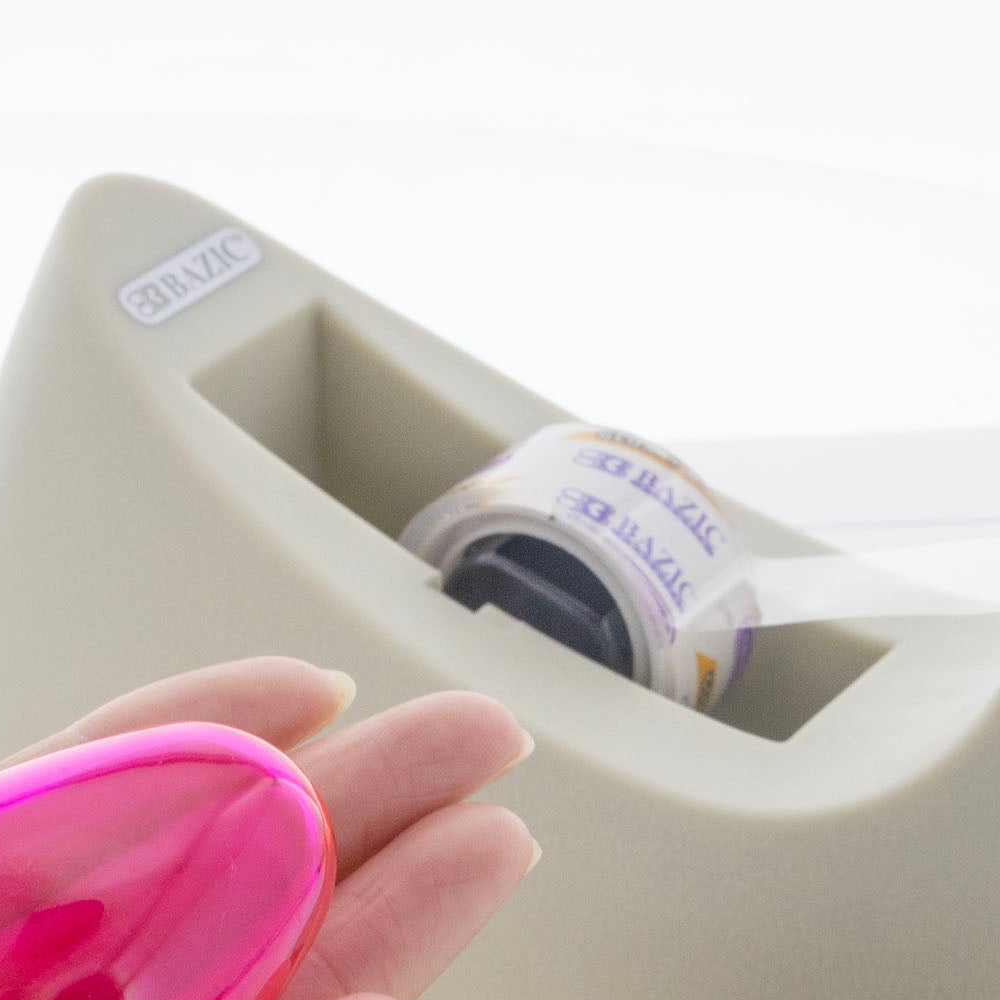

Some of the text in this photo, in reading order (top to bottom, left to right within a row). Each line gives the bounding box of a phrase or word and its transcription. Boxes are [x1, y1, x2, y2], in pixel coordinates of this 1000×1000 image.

[159, 233, 251, 299] BAZIC
[629, 468, 727, 558] BAZIC
[611, 516, 697, 614] BAZIC
